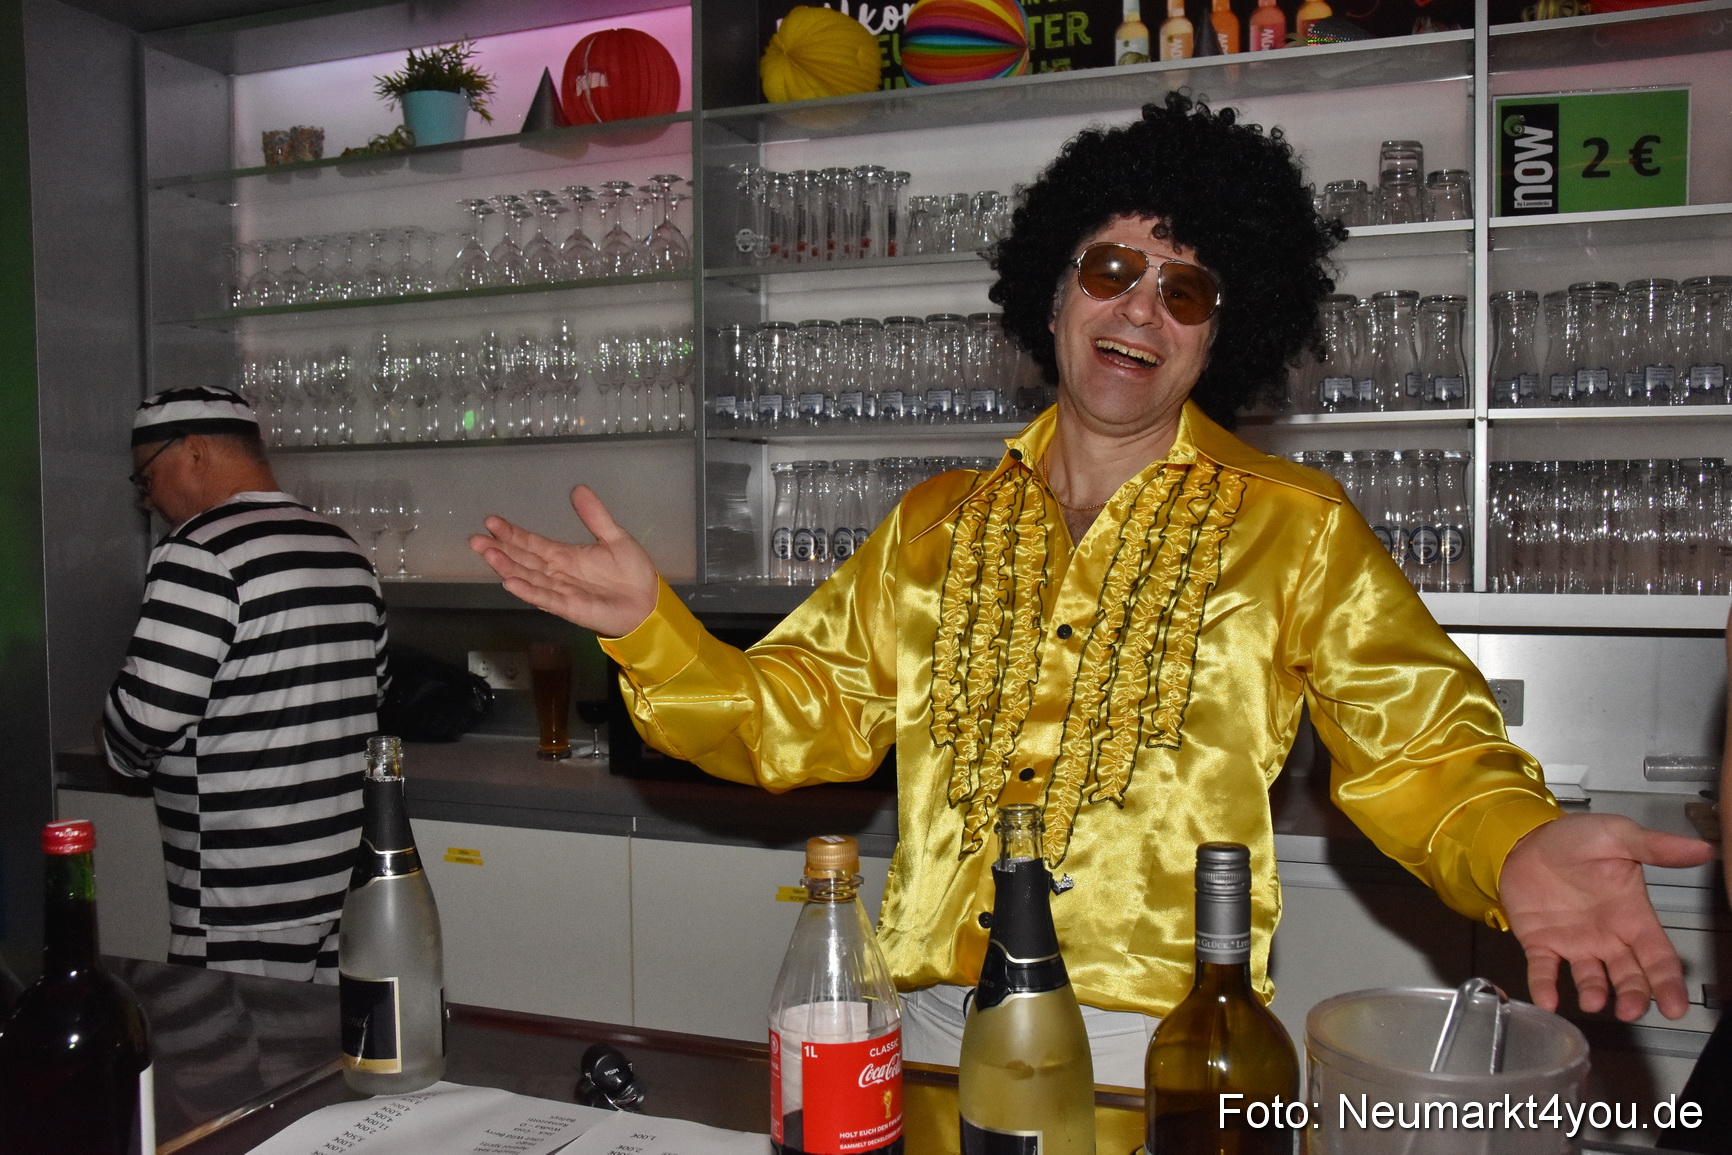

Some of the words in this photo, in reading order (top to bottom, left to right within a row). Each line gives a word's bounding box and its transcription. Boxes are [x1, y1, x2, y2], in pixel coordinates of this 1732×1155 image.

[1581, 137, 1611, 178] 2
[1628, 135, 1661, 177] €
[804, 1045, 818, 1058] 1L
[839, 1131, 858, 1139] HOLT
[859, 1127, 877, 1137] EUCH
